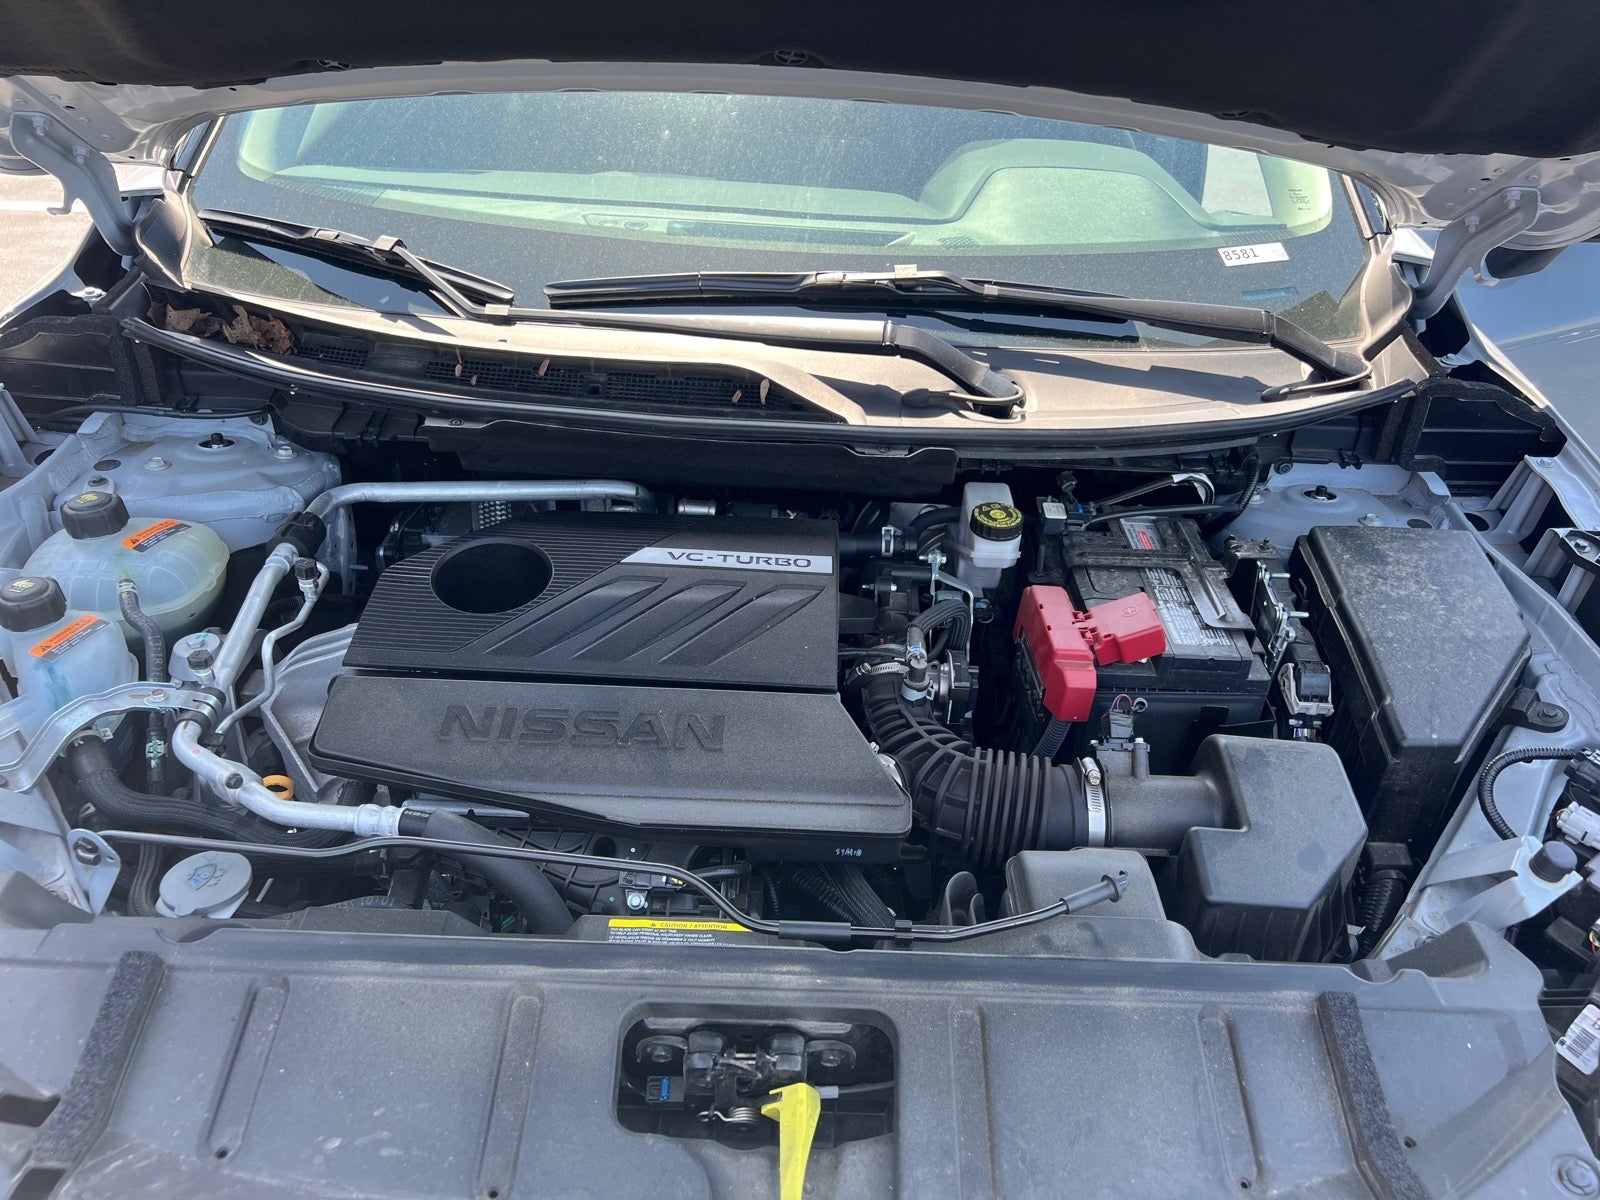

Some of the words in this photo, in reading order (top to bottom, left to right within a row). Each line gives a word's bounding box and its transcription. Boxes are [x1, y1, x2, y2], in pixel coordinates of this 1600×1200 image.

[1222, 248, 1259, 261] 8581
[666, 551, 812, 568] VC-TURBO
[437, 704, 726, 750] NISSAN
